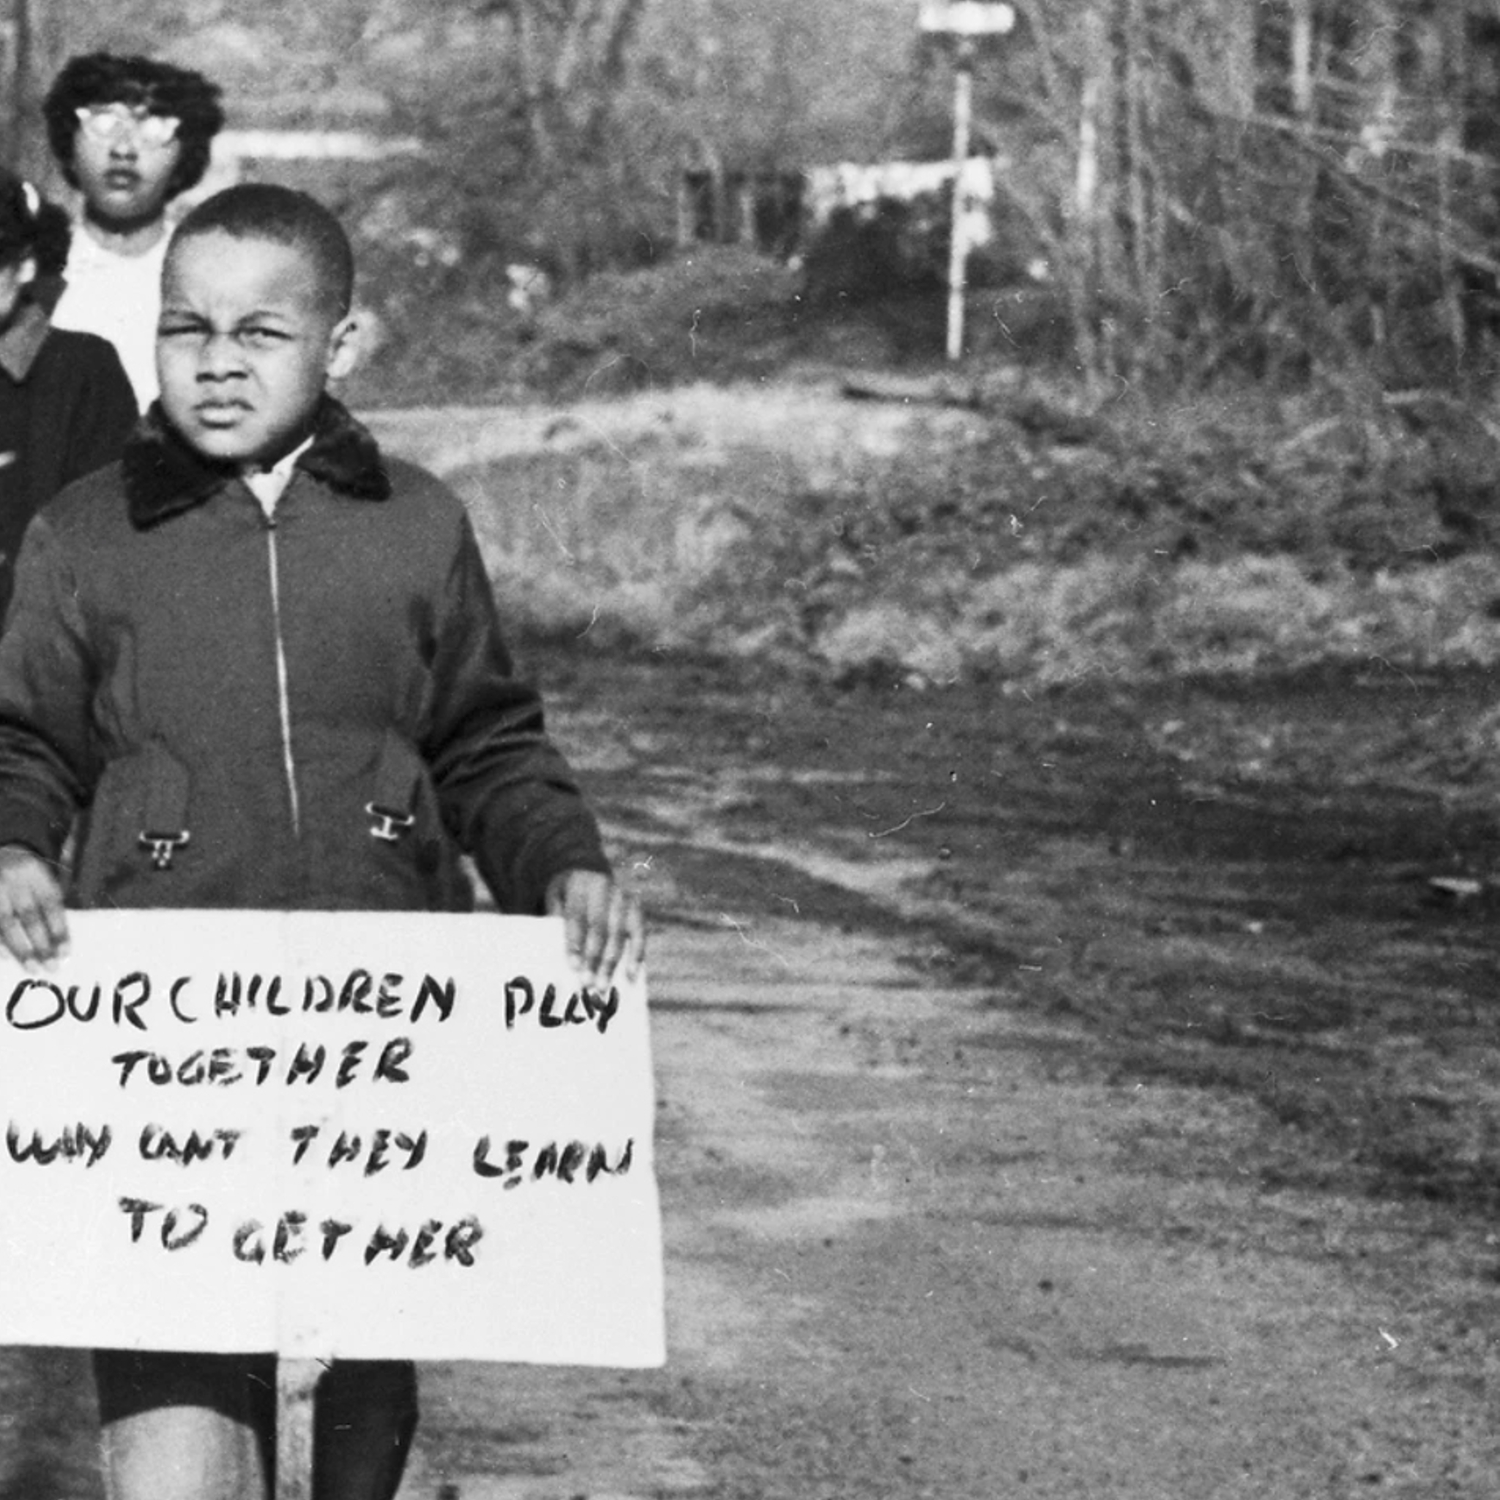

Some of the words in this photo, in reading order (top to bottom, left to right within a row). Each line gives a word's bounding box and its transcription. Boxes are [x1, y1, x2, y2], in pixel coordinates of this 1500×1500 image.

[6, 970, 151, 1030] OUR
[170, 969, 456, 1024] CHILDREN
[504, 977, 620, 1033] PLAY
[111, 1037, 413, 1089] TOGETHER
[6, 1119, 113, 1167] WHY
[139, 1123, 242, 1164] CANT
[291, 1124, 427, 1177] THEY
[473, 1135, 633, 1189] LEARN
